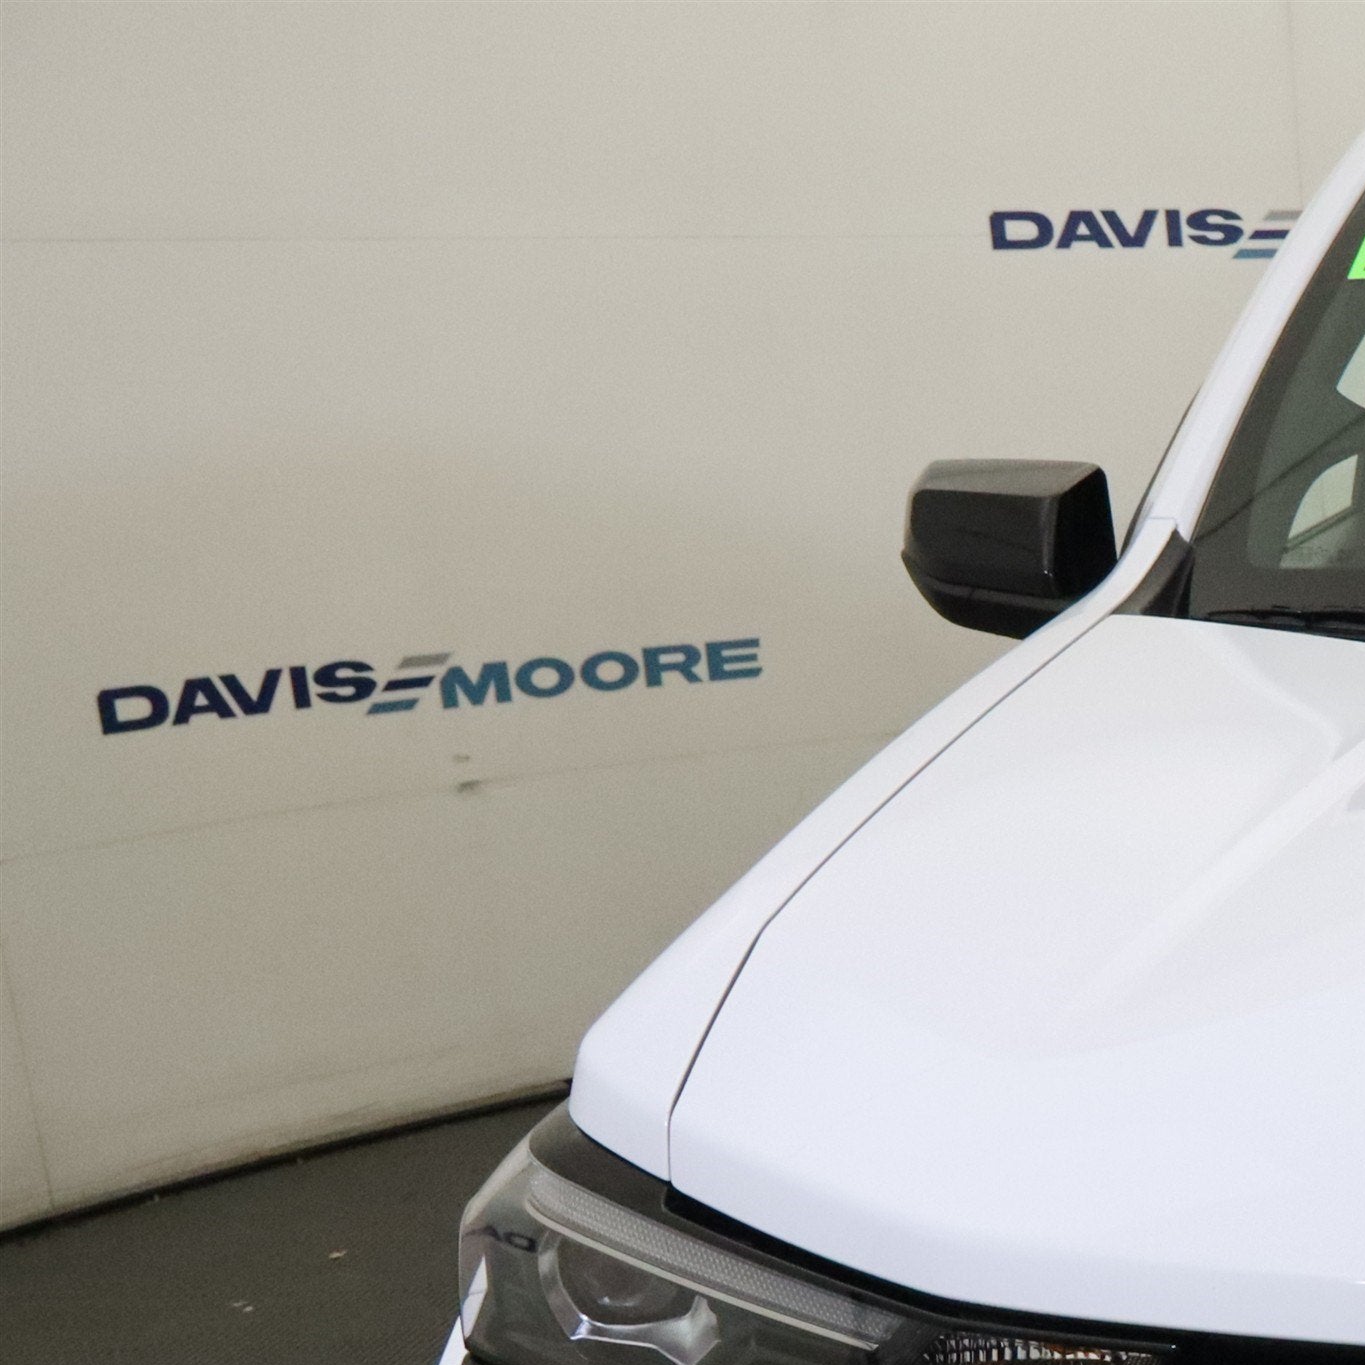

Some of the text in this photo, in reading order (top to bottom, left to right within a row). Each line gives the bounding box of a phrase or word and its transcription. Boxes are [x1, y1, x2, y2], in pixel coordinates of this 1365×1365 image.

[989, 208, 1242, 251] DAVIS
[97, 637, 764, 736] DAVIS MOORE
